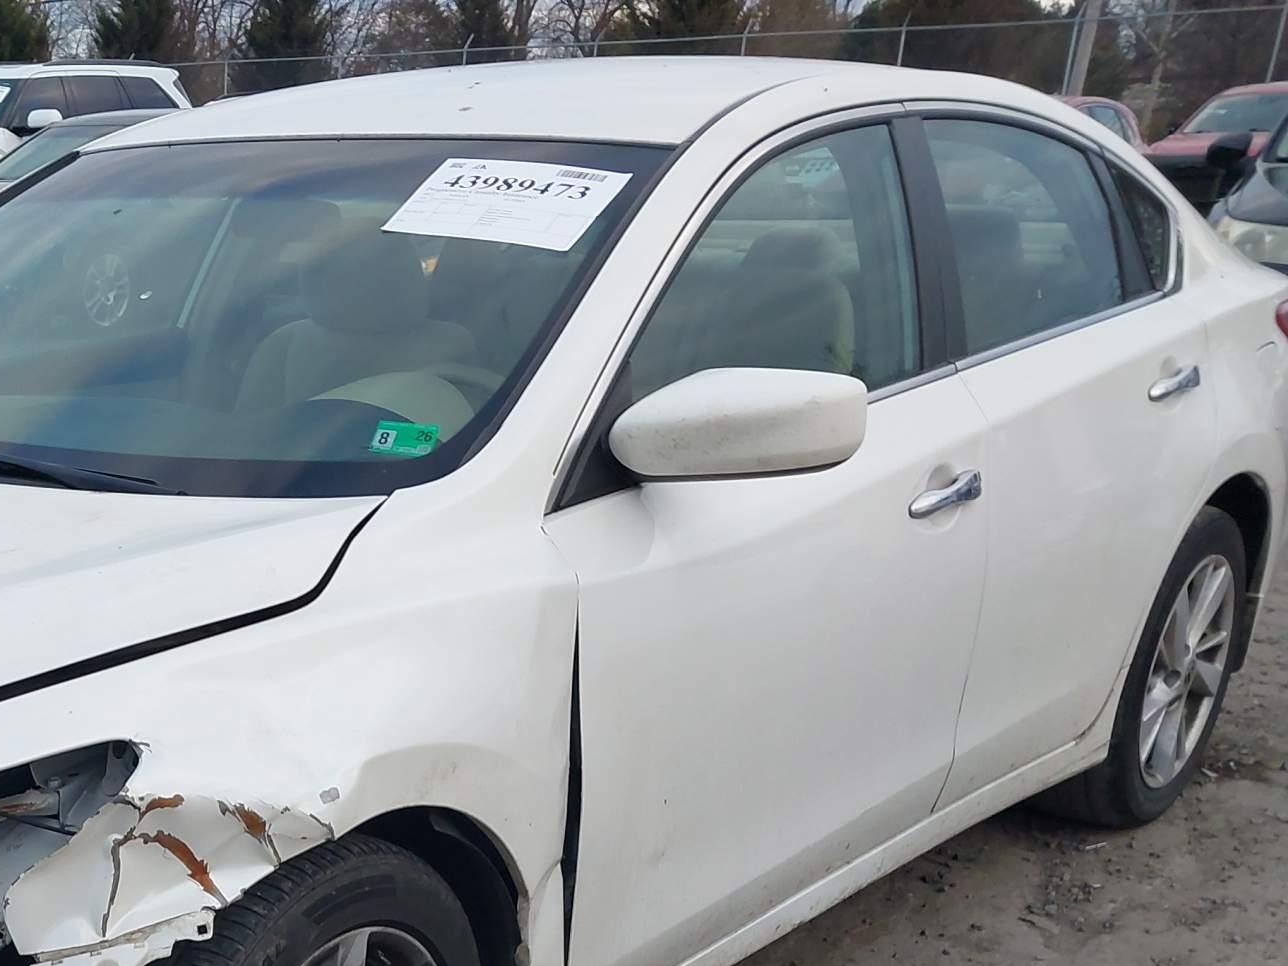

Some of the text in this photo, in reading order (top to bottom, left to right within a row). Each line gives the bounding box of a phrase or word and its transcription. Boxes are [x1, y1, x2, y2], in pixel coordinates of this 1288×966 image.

[444, 174, 591, 200] 43989473
[378, 430, 434, 445] 8 26
